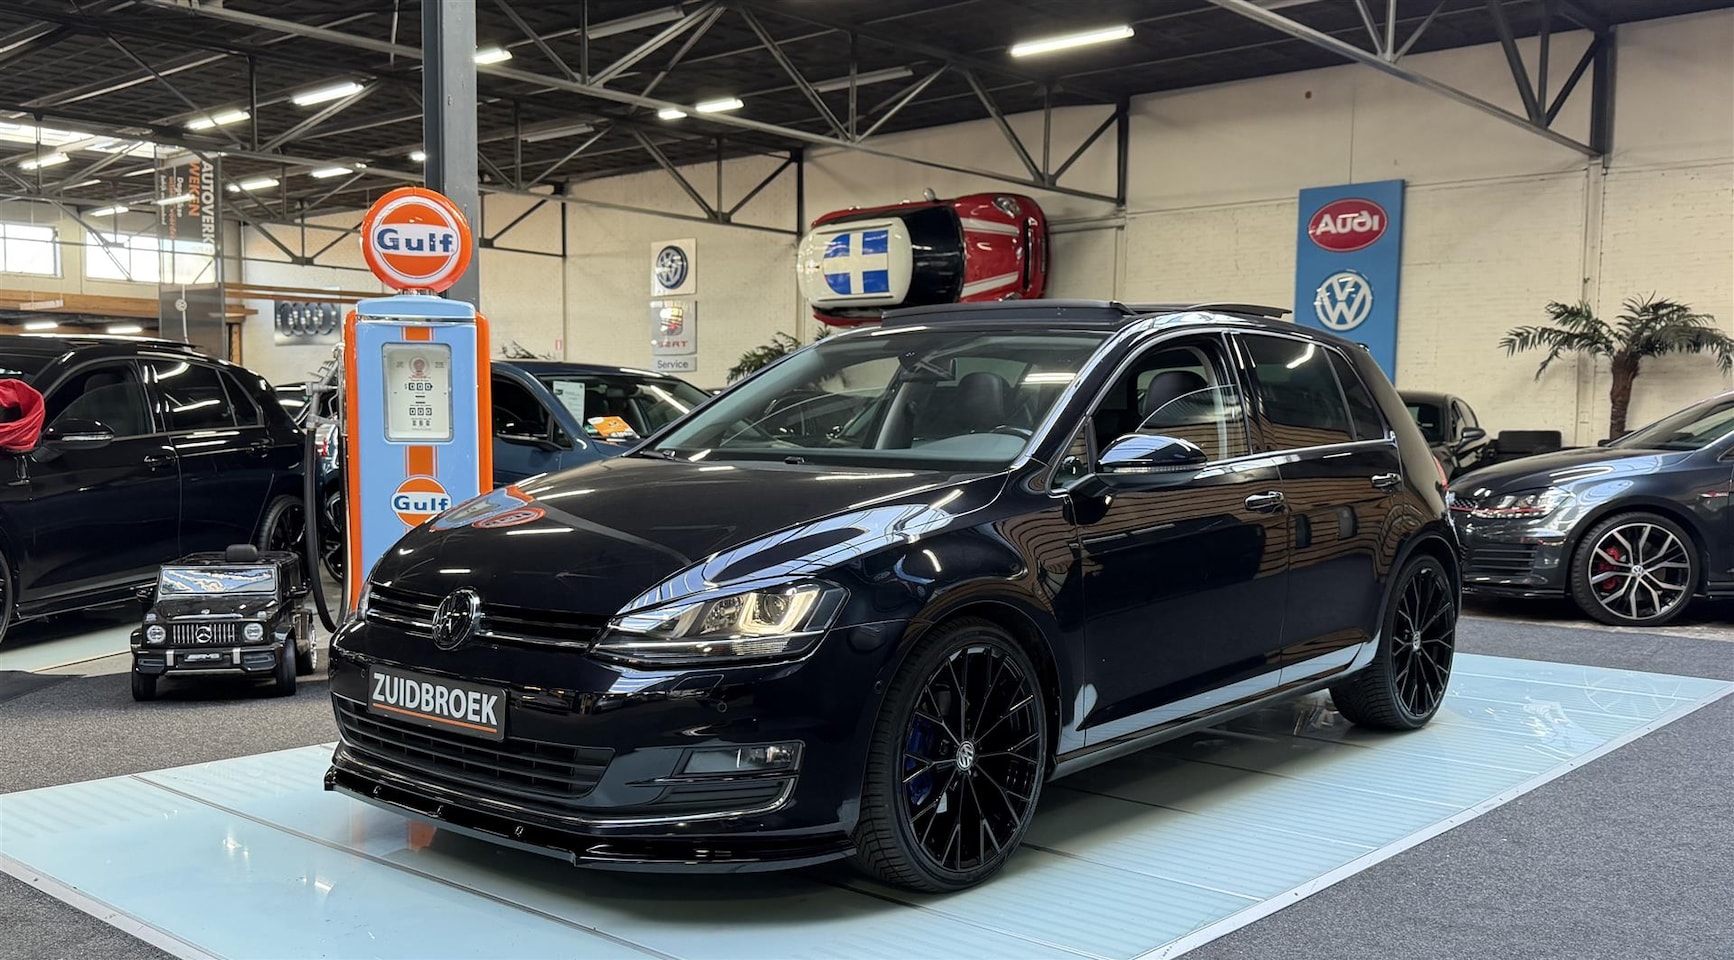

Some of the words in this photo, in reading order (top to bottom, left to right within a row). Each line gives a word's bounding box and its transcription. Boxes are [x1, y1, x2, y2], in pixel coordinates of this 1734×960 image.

[202, 161, 215, 249] AUTOVERK
[377, 228, 453, 252] Gulf
[657, 359, 689, 369] Service
[394, 495, 449, 511] Gulf
[372, 672, 498, 726] ZUIDBROEK
